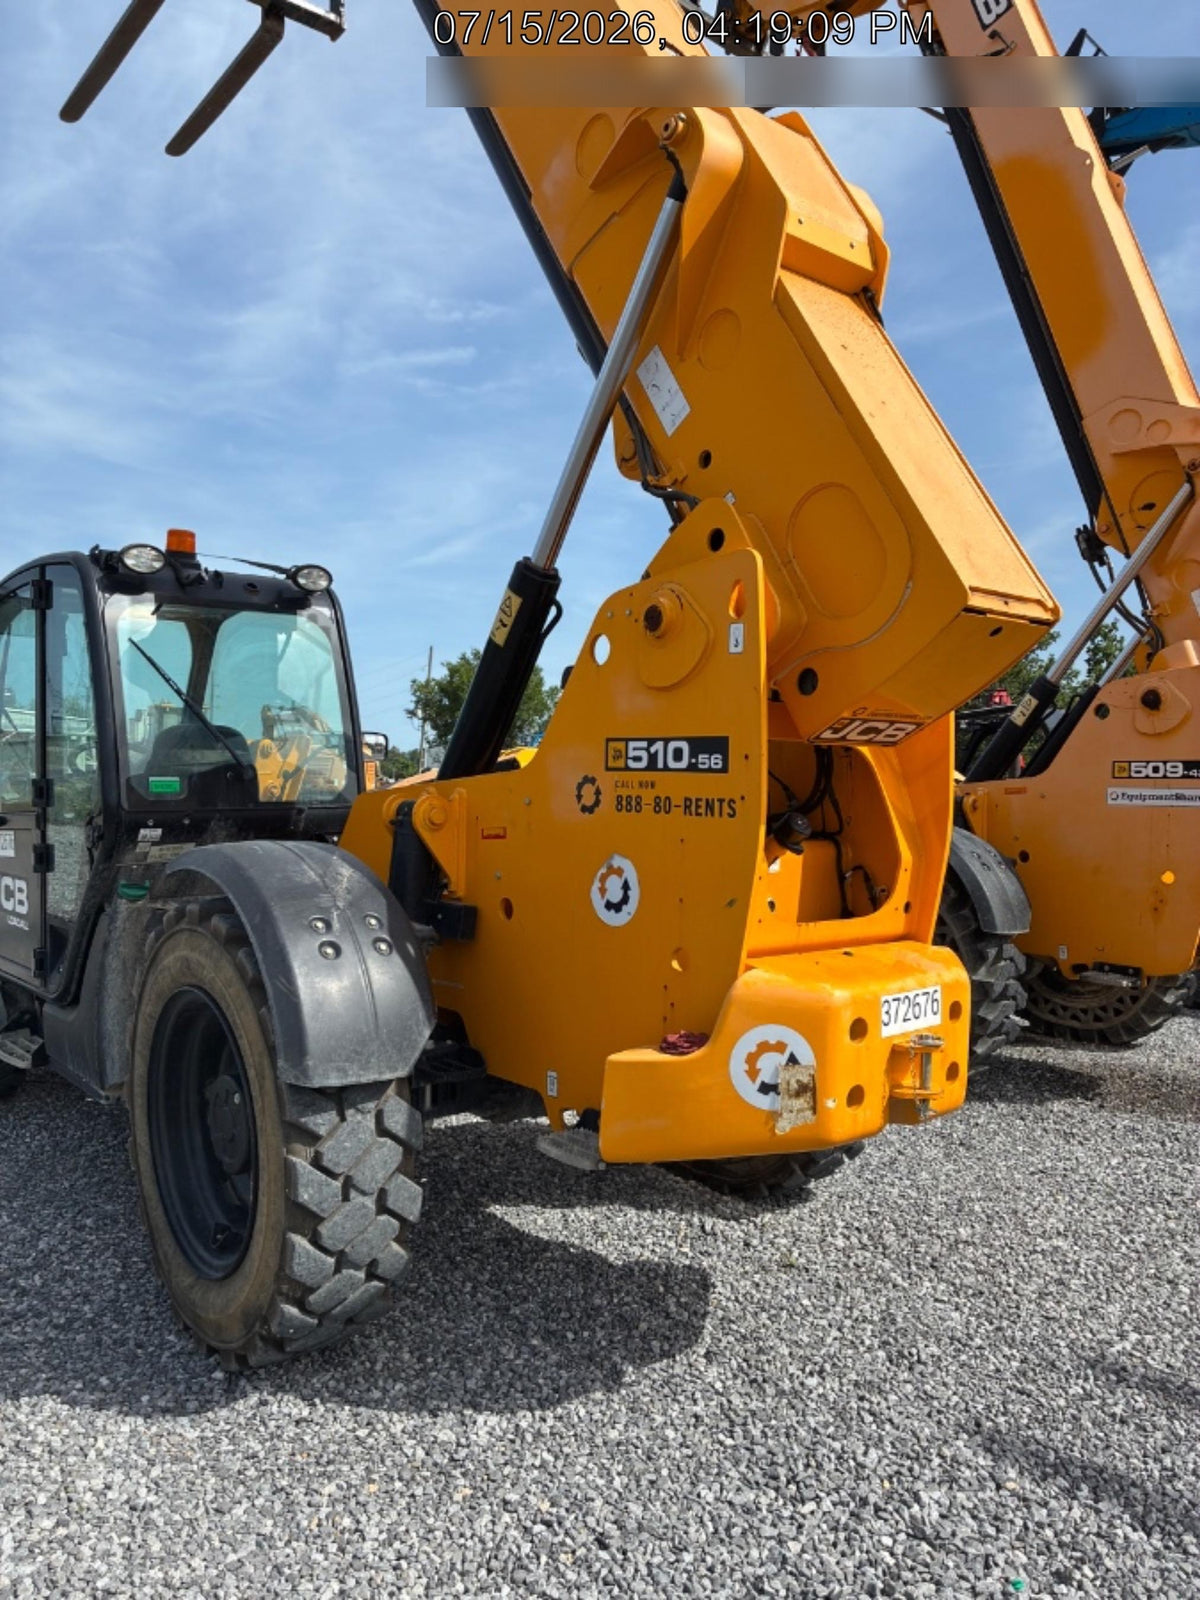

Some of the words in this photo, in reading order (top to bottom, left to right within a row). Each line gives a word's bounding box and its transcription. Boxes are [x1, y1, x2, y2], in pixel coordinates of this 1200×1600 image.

[819, 719, 918, 743] JCB
[1130, 762, 1200, 778] 509-4
[615, 780, 635, 790] CALL
[638, 780, 656, 790] NOW
[615, 794, 737, 818] 888-80-RENTS
[1121, 792, 1200, 803] EquipmentShar
[881, 989, 940, 1027] 372676
